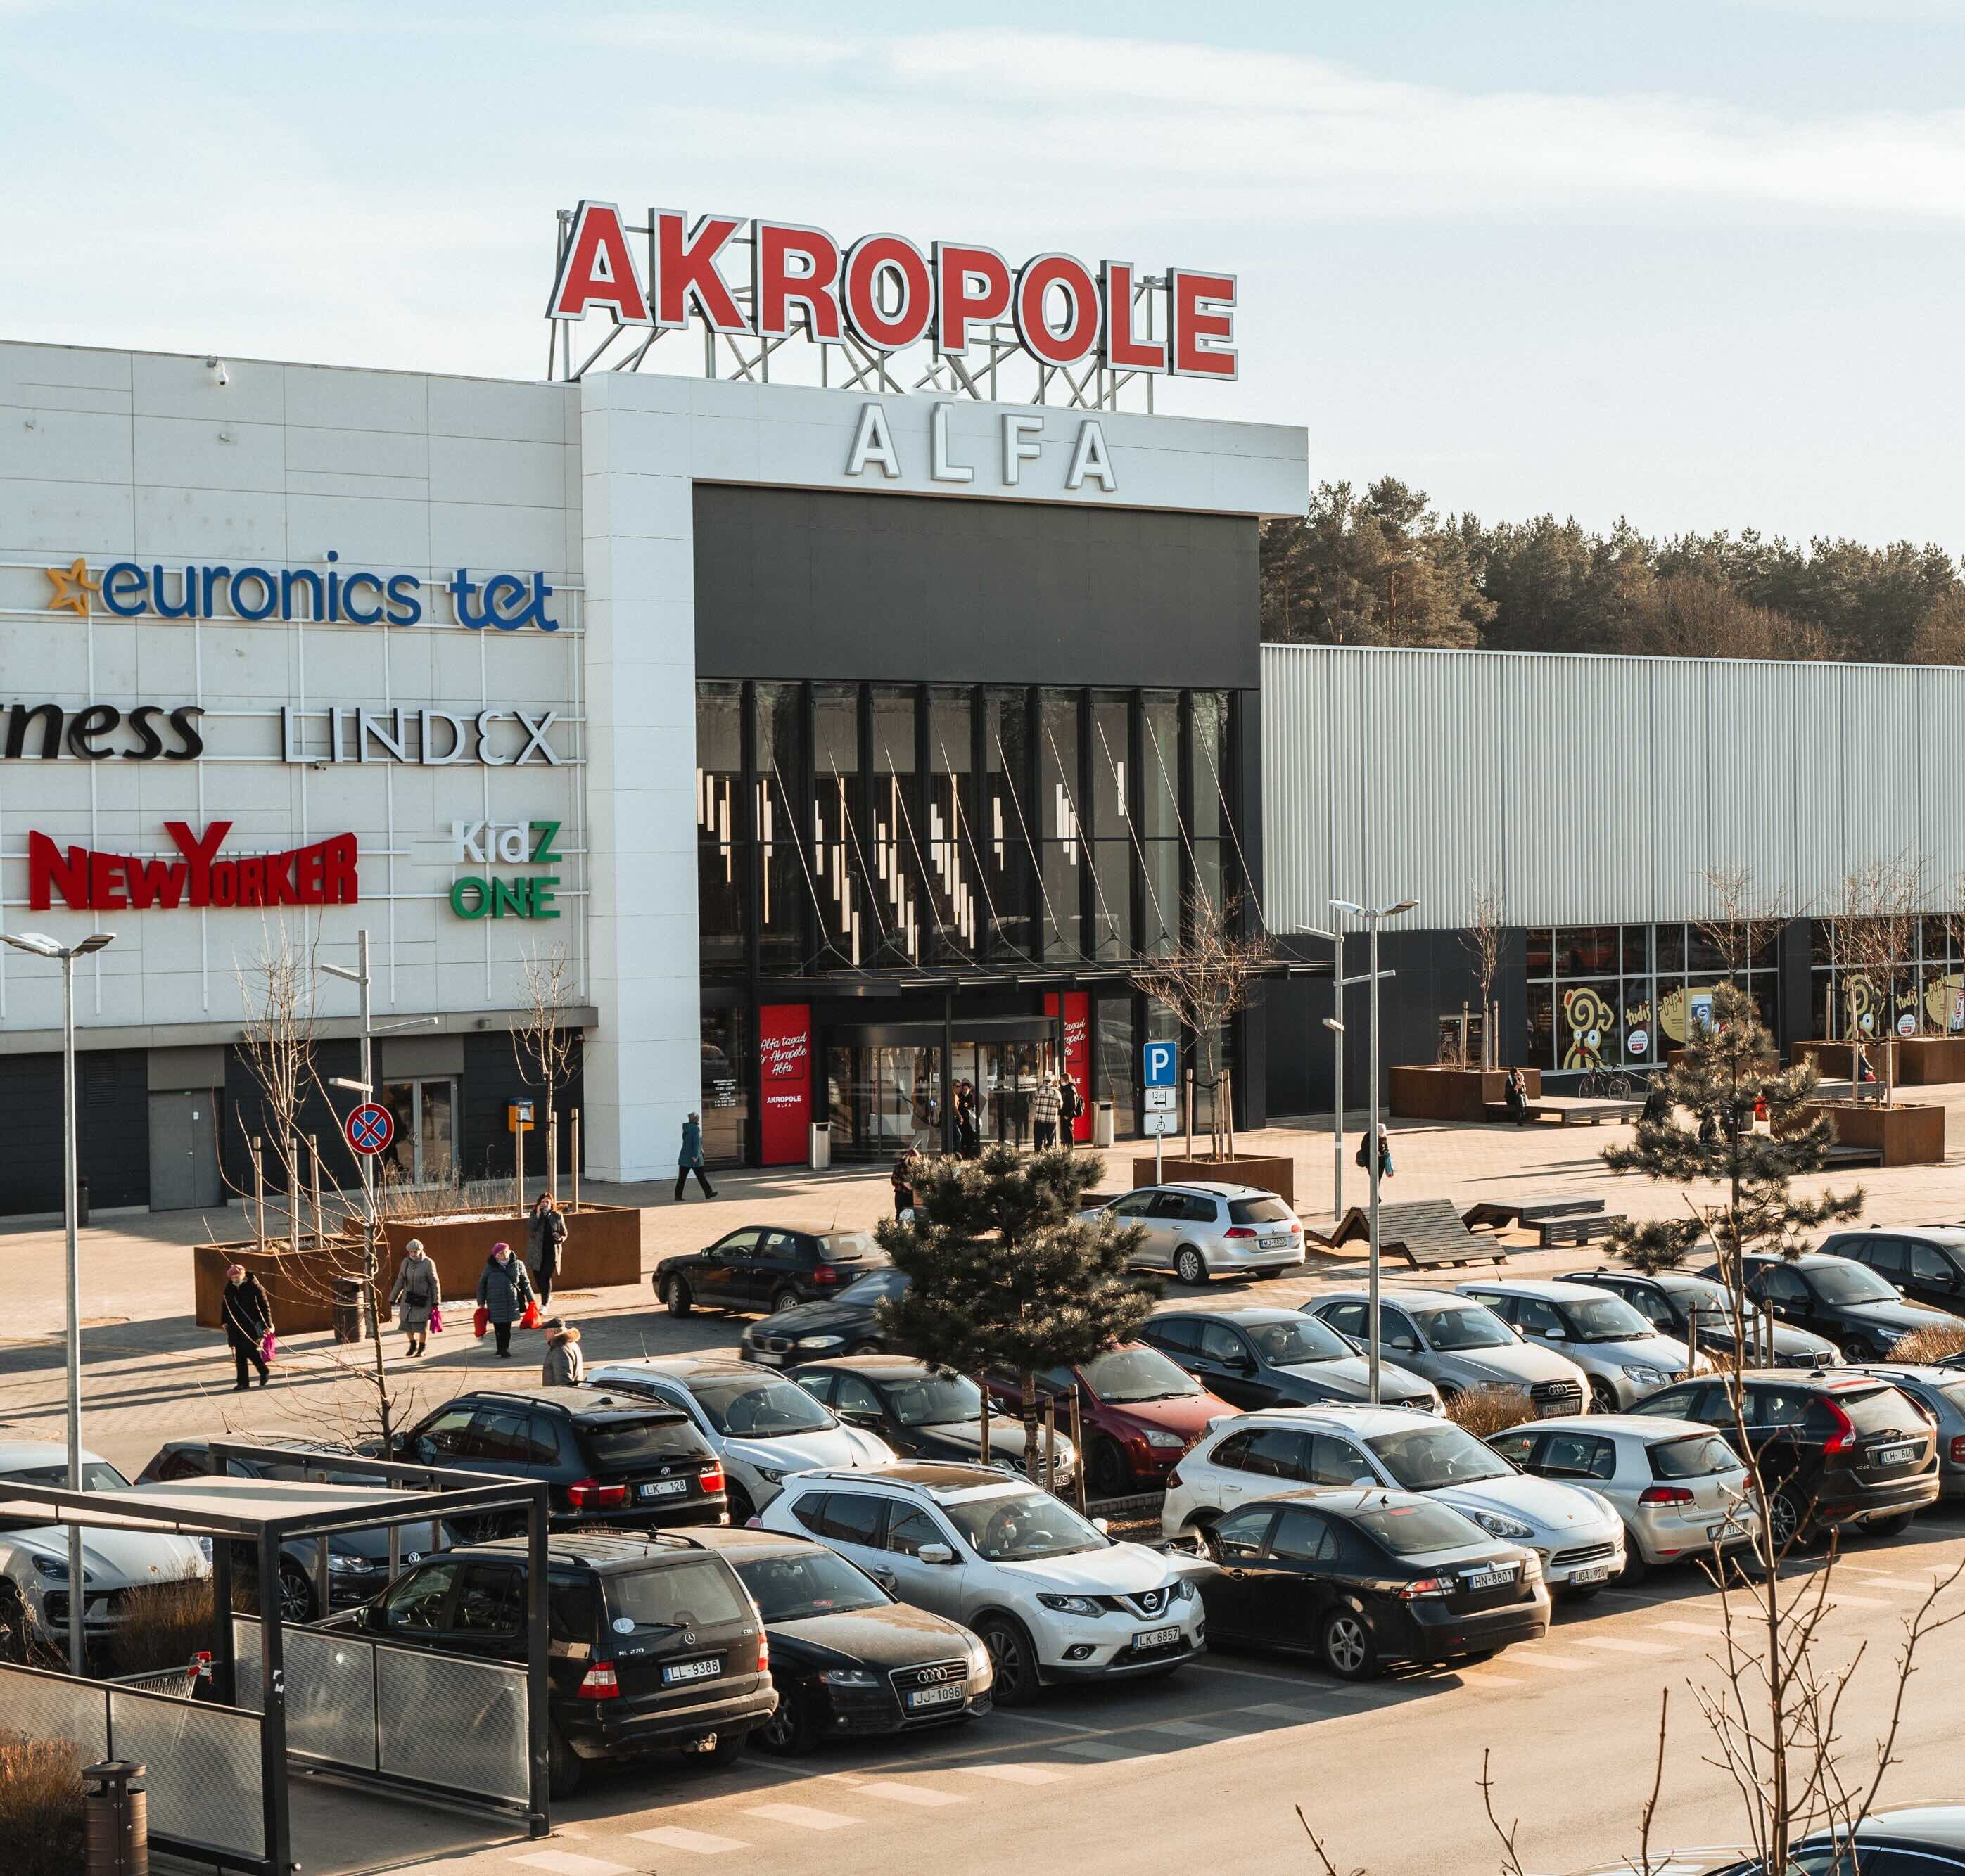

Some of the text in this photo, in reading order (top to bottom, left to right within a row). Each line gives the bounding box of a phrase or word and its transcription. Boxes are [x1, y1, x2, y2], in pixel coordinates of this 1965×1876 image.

[545, 200, 1239, 381] AKROPOLE
[844, 402, 1117, 492] ALFA
[101, 550, 422, 627] euronics
[448, 568, 560, 632] tet
[0, 703, 205, 760] ness
[280, 706, 561, 765] LINDEX
[450, 876, 561, 920] ONE
[760, 1031, 808, 1051] Alfa tagad
[770, 1047, 807, 1063] Akropole
[1152, 1048, 1169, 1081] P
[772, 1062, 793, 1076] Alfa
[767, 1095, 801, 1104] AKROPOLE
[1475, 1571, 1513, 1587] HN-8801
[1140, 1628, 1178, 1645] LK-6857
[670, 1660, 719, 1679] LL-9388
[916, 1687, 960, 1704] JJ-1096
